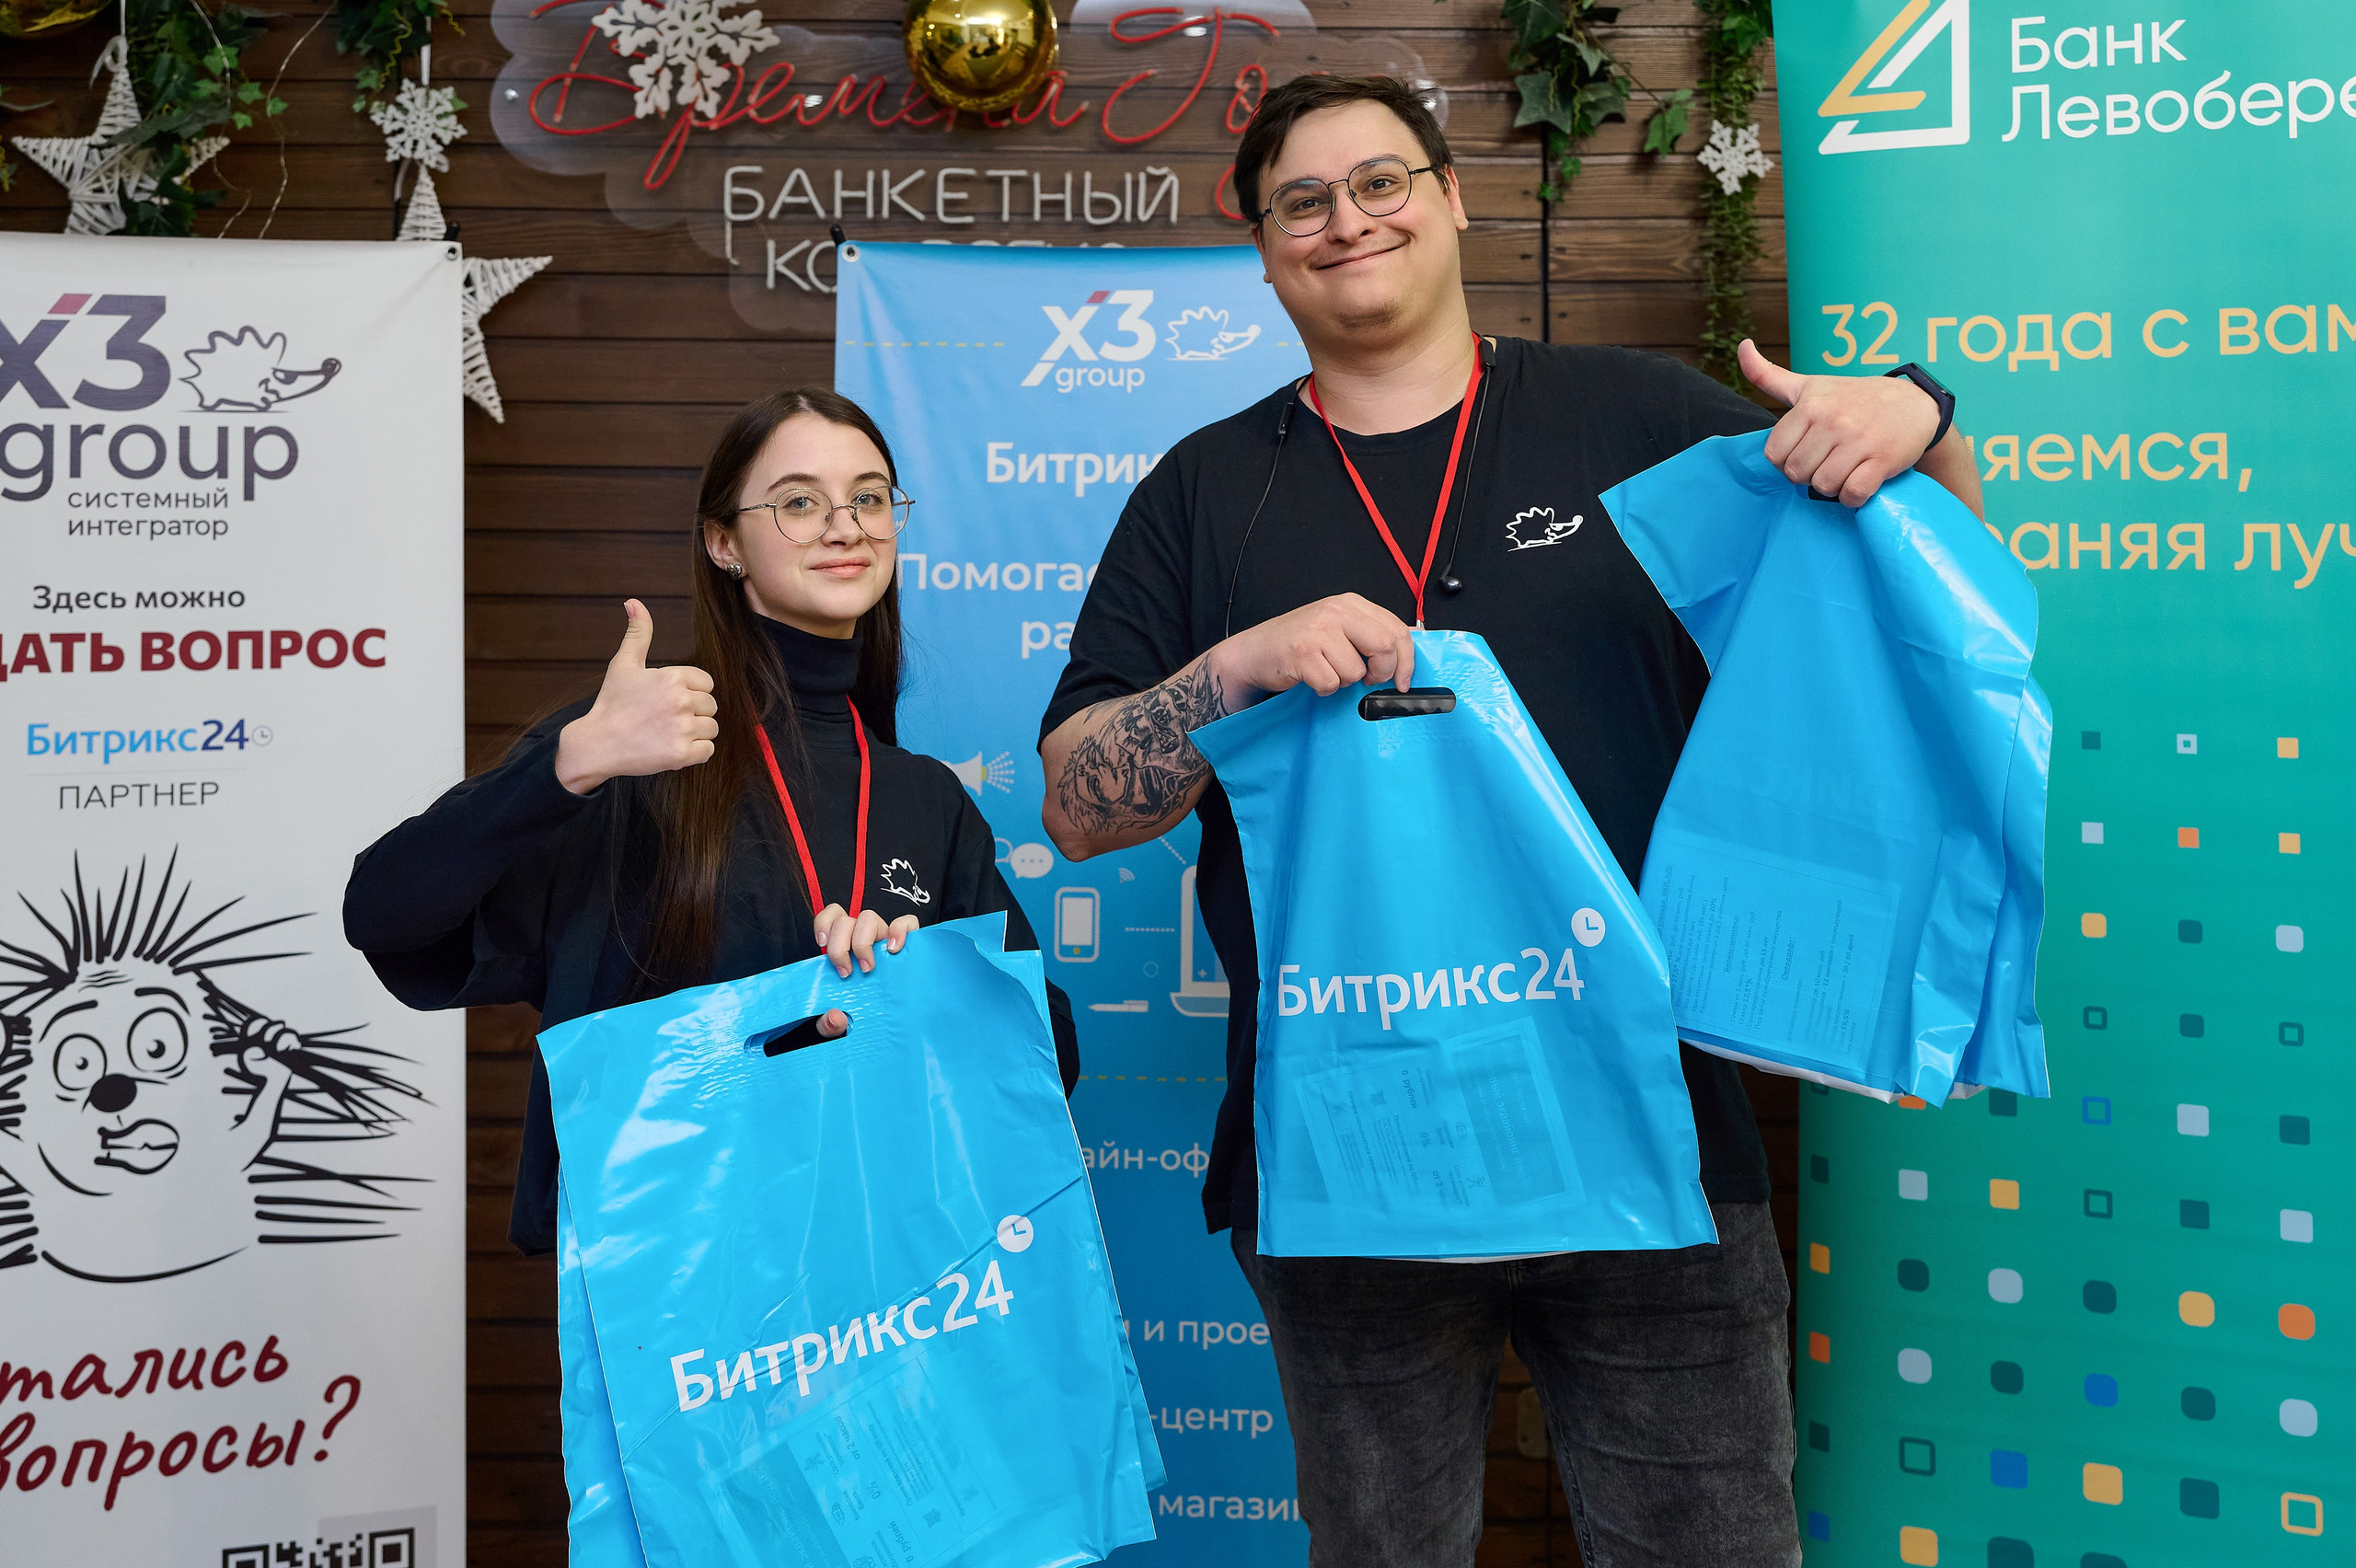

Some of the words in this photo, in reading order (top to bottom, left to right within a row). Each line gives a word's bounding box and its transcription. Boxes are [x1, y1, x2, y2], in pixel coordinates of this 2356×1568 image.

[2011, 17, 2188, 74] Банк
[723, 166, 1180, 225] БАНКЕТНЫЙ
[1820, 302, 1900, 367] 32
[1928, 311, 2112, 372] года
[2142, 309, 2189, 358] с
[1055, 365, 1146, 393] group
[0, 423, 299, 502] group
[68, 488, 228, 510] системный
[68, 516, 229, 540] интегратор
[1985, 522, 2206, 572] аняя
[32, 585, 127, 613] Здесь
[135, 589, 246, 610] можно
[0, 632, 125, 682] АТЬ
[140, 628, 387, 673] ВОПРОС
[27, 718, 249, 765] Битрикс24
[58, 781, 220, 811] ПАРТНЕР
[1277, 947, 1585, 1031] Битрикс24
[670, 1260, 1014, 1412] Битрикс24
[1145, 1320, 1164, 1342] и
[885, 1518, 912, 1553] рублей
